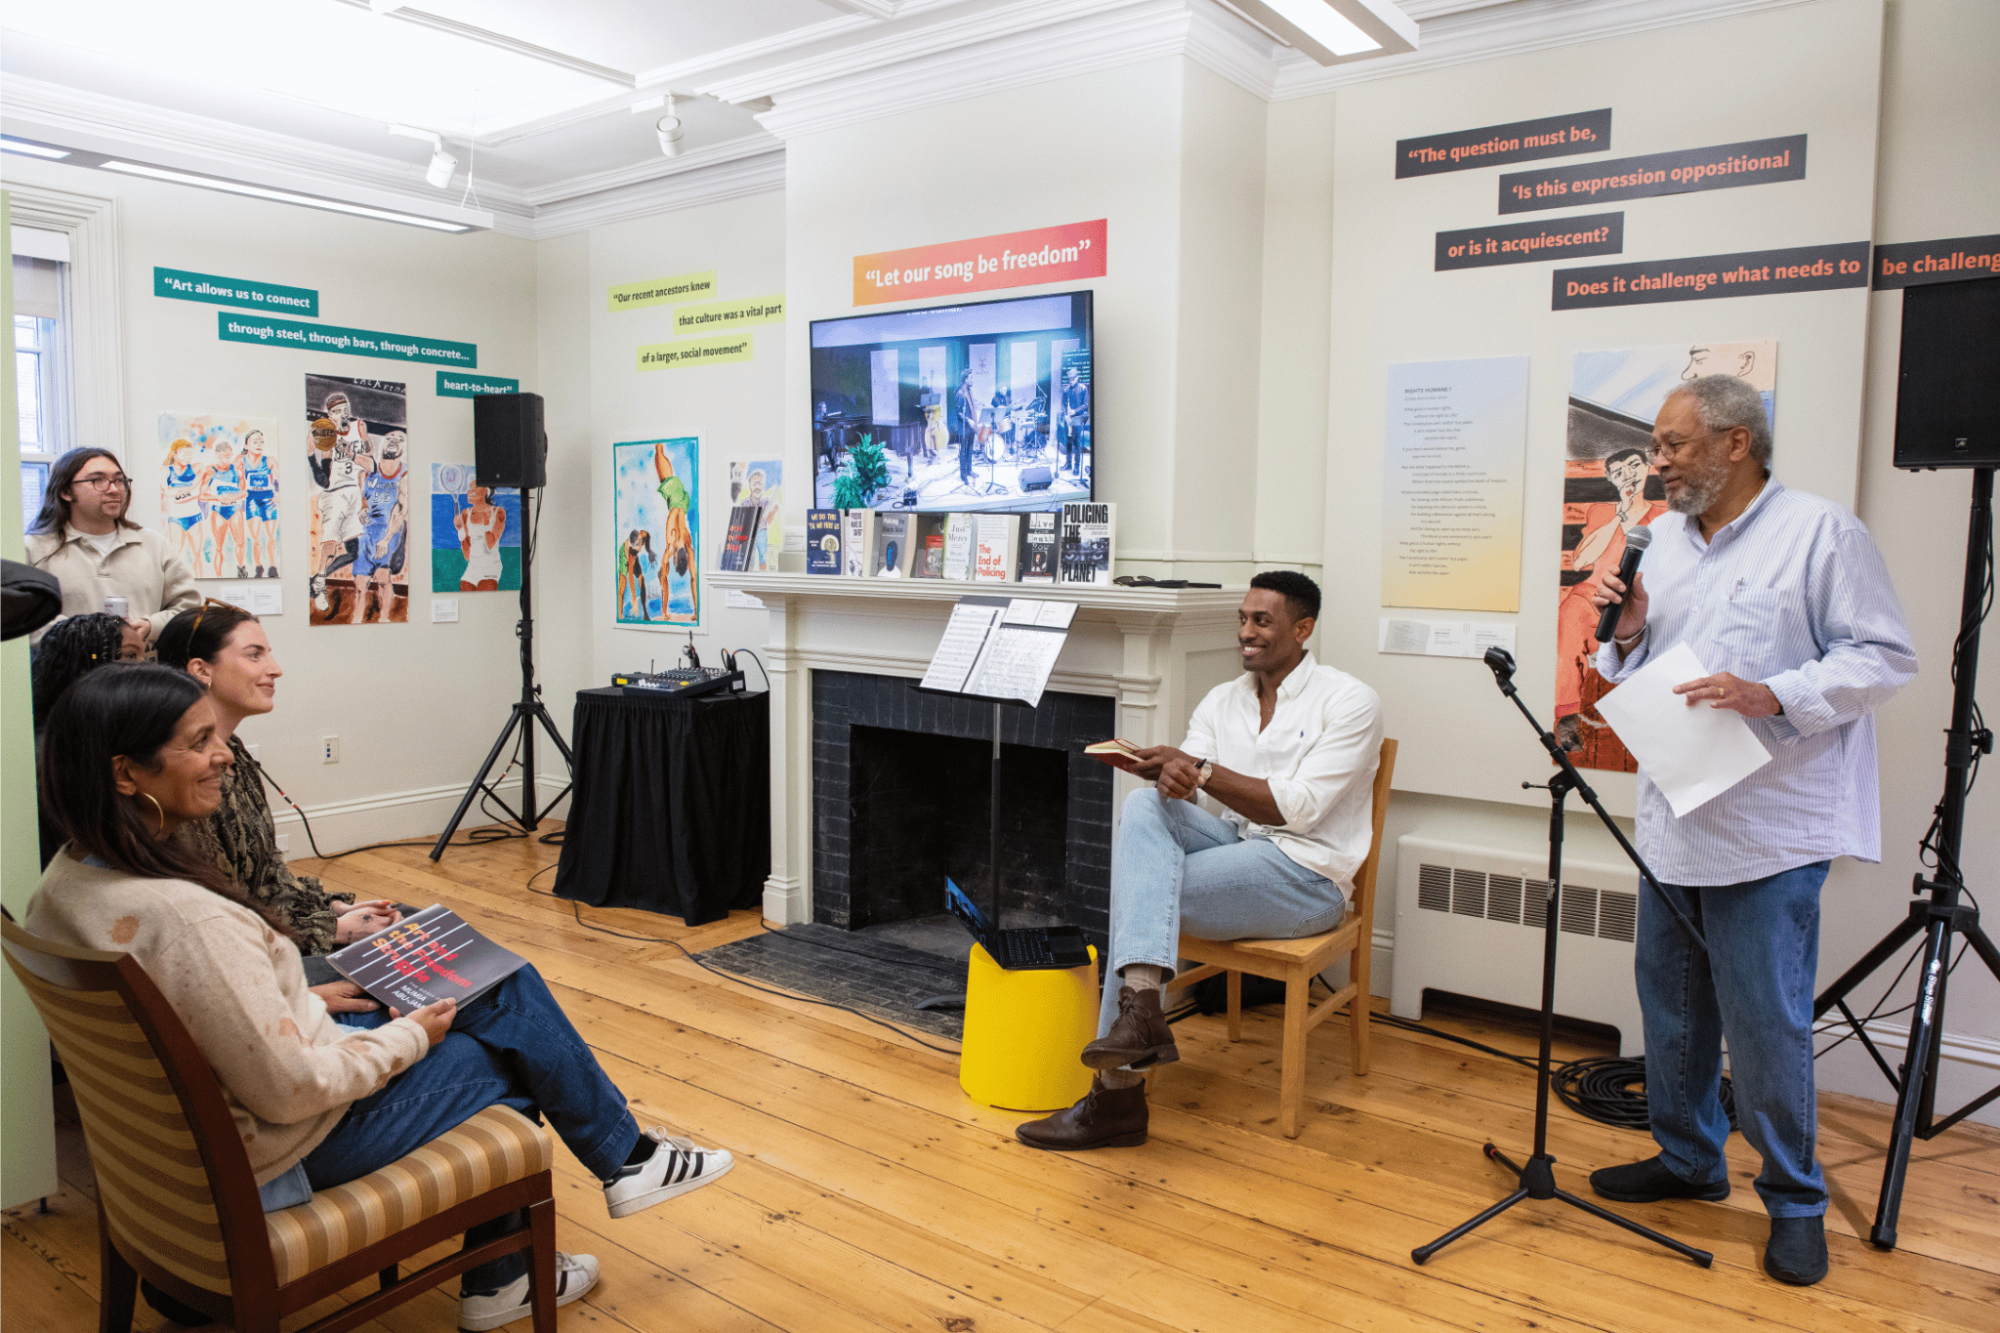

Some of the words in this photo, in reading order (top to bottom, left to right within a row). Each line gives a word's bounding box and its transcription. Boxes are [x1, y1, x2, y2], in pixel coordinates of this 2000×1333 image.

[1408, 148, 1447, 164] “The
[1450, 137, 1520, 163] question
[1524, 130, 1566, 149] must
[1570, 126, 1597, 144] be,
[1512, 185, 1532, 200] ‘Is
[1536, 179, 1567, 198] this
[1572, 169, 1666, 195] expression
[1671, 150, 1790, 184] oppositional
[1448, 245, 1465, 258] or
[1469, 240, 1482, 256] is
[1486, 238, 1498, 254] it
[1502, 227, 1610, 254] acquiescent?
[866, 270, 900, 288] “Let
[904, 266, 931, 284] our
[934, 260, 974, 283] song
[978, 254, 998, 274] be
[1002, 239, 1092, 271] freedom”
[1567, 281, 1609, 297] Does
[1613, 277, 1626, 293] it
[1631, 272, 1718, 292] challenge
[1722, 266, 1770, 284] what
[1775, 259, 1834, 280] needs
[1840, 259, 1861, 274] to
[1882, 259, 1907, 276] be
[165, 277, 192, 292] “Art
[195, 283, 233, 297] allows
[236, 289, 249, 299] us
[252, 291, 264, 301] to
[266, 295, 310, 308] connect
[614, 293, 630, 303] “Our
[632, 290, 654, 301] recent
[655, 286, 689, 297] ancestors
[691, 281, 711, 292] knew
[679, 315, 694, 326] that
[696, 312, 722, 324] culture
[724, 312, 738, 320] was
[740, 310, 744, 318] a
[746, 305, 764, 317] vital
[765, 304, 782, 318] part
[228, 322, 274, 339] through
[276, 329, 307, 343] steel,
[309, 332, 351, 349] through
[353, 337, 379, 351] bars,
[380, 341, 419, 356] through
[421, 347, 470, 361] concrete...
[642, 353, 650, 364] of
[651, 354, 655, 362] a
[657, 350, 679, 364] larger,
[681, 347, 701, 360] social
[703, 342, 747, 357] movement”
[444, 379, 512, 394] heart-to-heart”
[345, 462, 353, 475] 3
[1064, 504, 1108, 524] POLICING
[1064, 524, 1081, 544] THE
[979, 544, 991, 554] The
[978, 555, 991, 565] End
[992, 555, 1001, 566] of
[978, 566, 1005, 580] Policing
[1062, 563, 1097, 583] PLANET
[404, 922, 431, 942] Art
[427, 941, 459, 962] and
[372, 938, 431, 984] Struggle
[389, 930, 414, 950] the
[412, 948, 473, 989] Freedom
[391, 989, 428, 1010] ABU-JAM
[400, 984, 427, 1003] MUMIA
